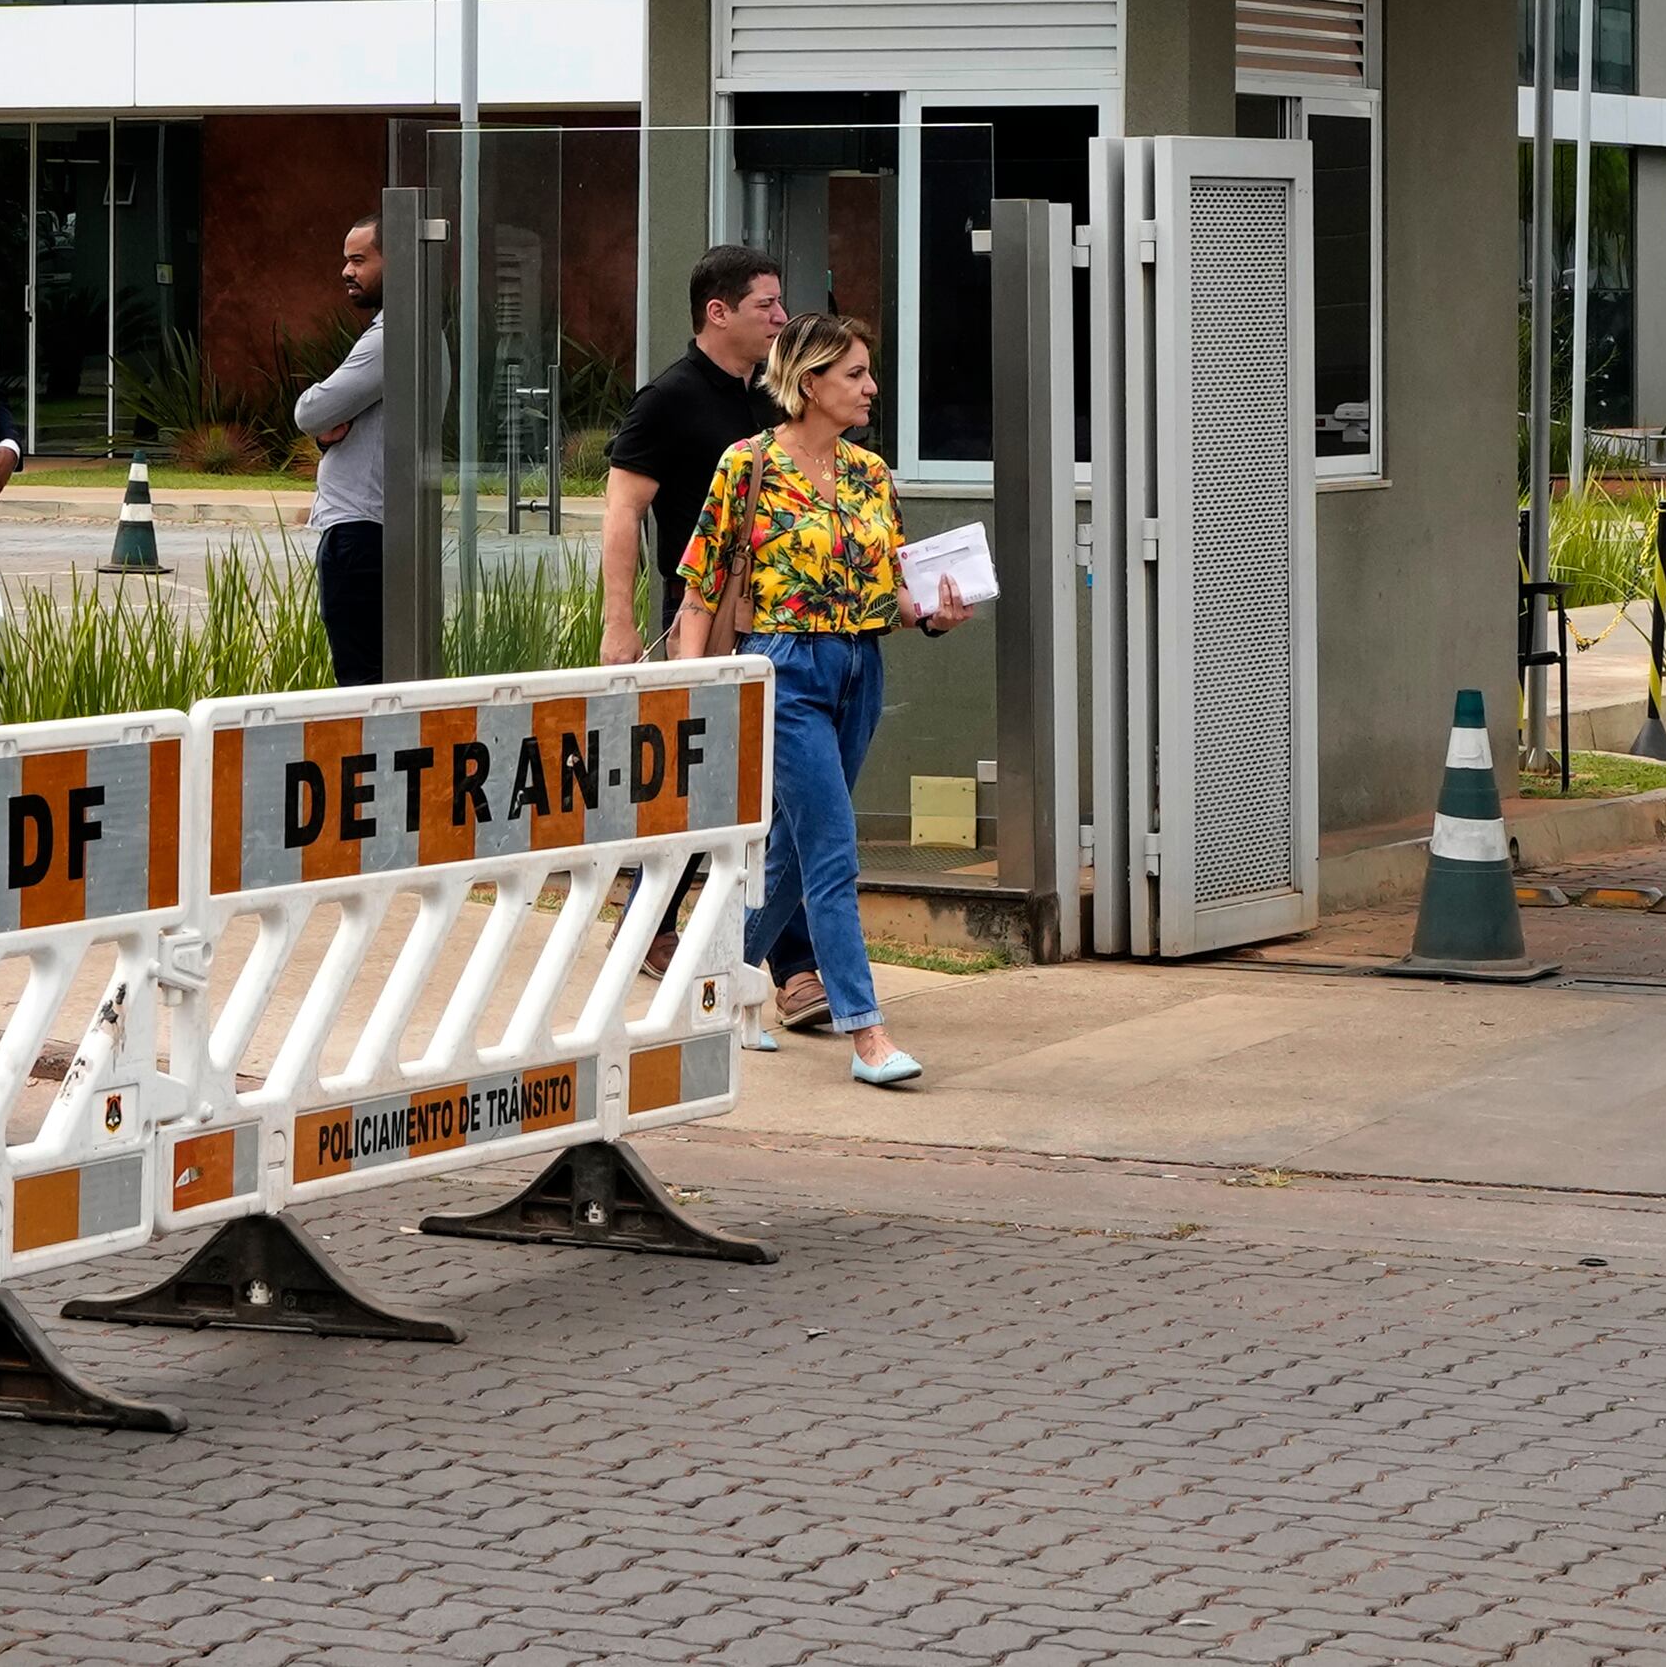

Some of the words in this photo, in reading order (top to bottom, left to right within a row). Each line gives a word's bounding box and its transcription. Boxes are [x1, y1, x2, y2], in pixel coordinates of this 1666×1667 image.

[317, 1099, 453, 1165] POLICIAMENTO
[458, 1093, 482, 1134] DE
[486, 1072, 572, 1128] TRÂNSITO
